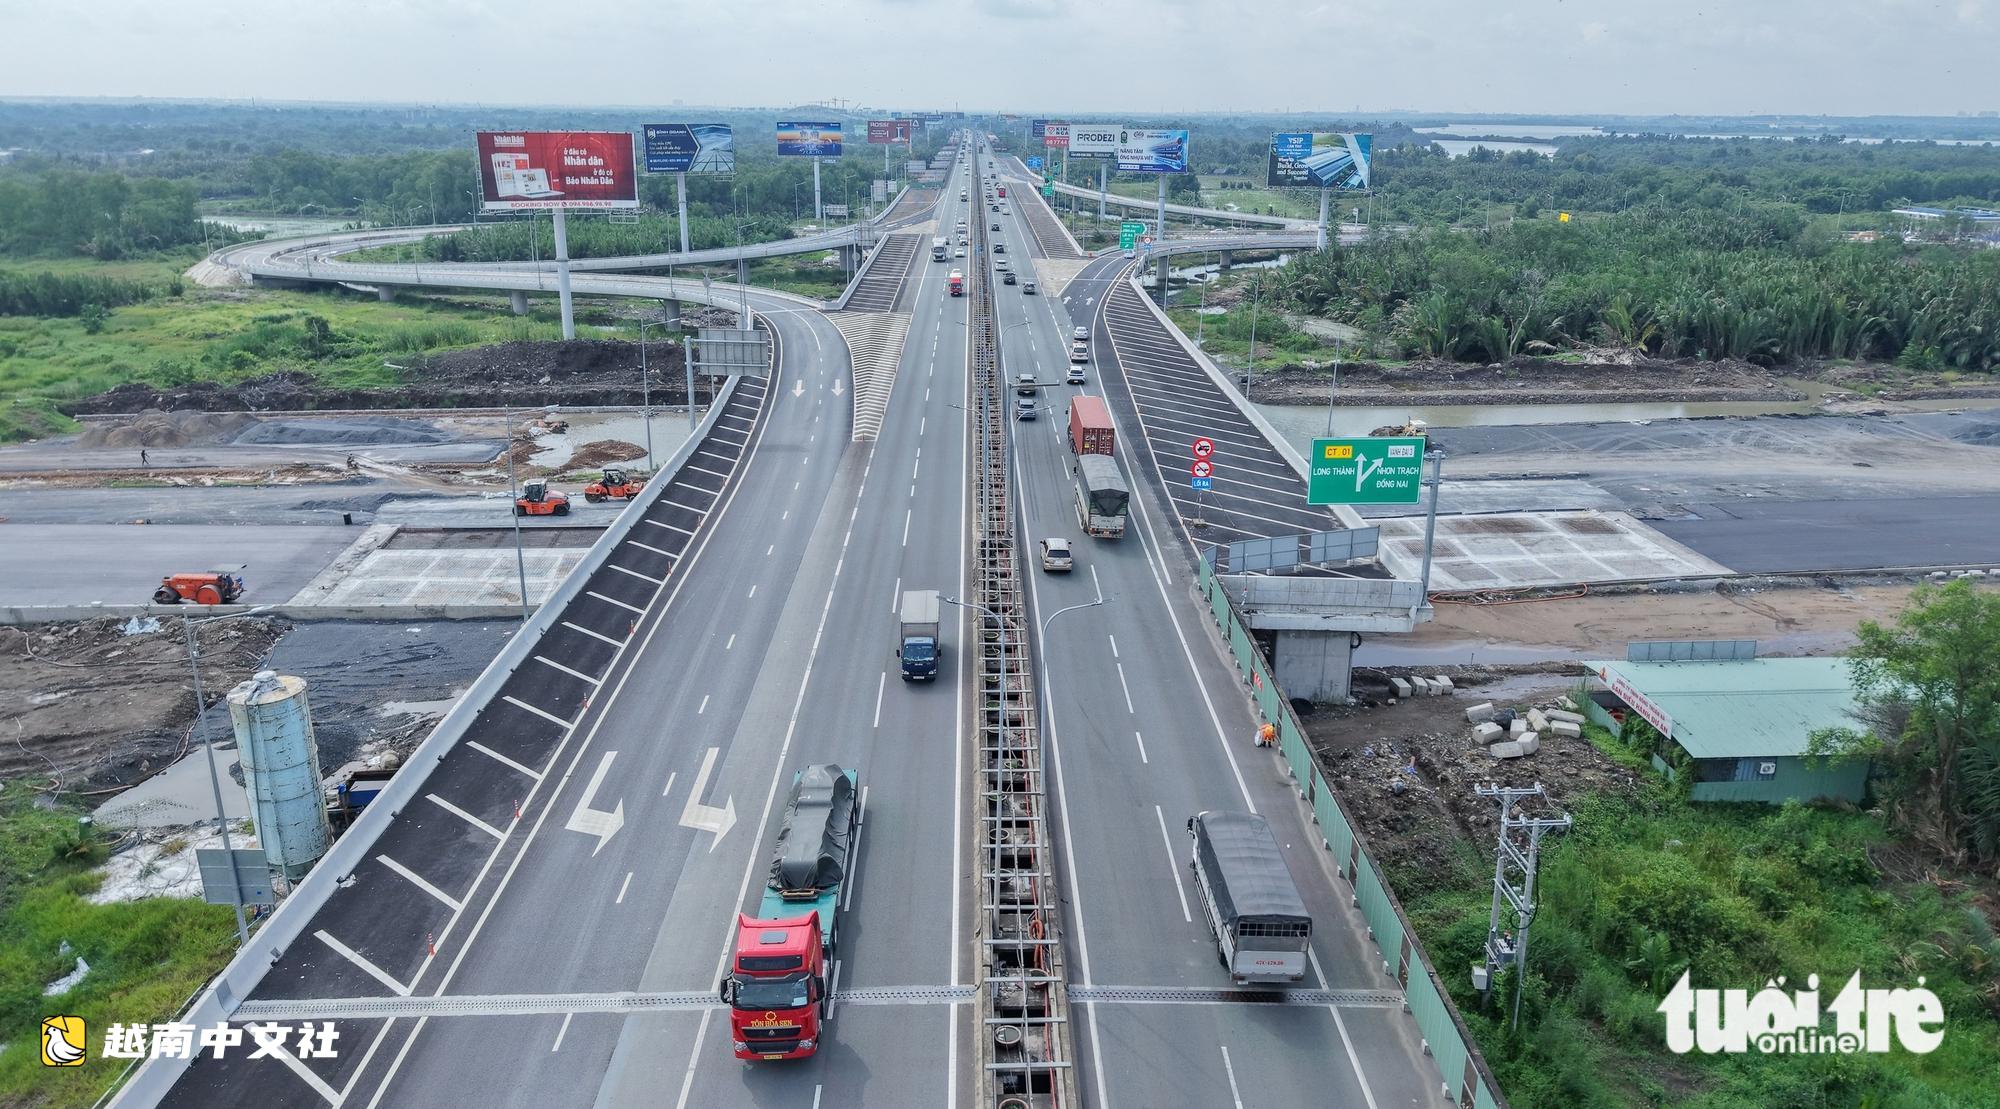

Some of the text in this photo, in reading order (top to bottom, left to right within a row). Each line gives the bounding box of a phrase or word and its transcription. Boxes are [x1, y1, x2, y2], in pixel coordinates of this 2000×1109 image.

[1077, 133, 1115, 142] PRODEZI
[564, 155, 604, 166] Nhân dân
[566, 176, 614, 185] Báo Nhân Dân
[1313, 465, 1356, 476] LONG THÀNH
[1376, 465, 1419, 477] NHƠN TRẠCH
[1376, 478, 1408, 488] ĐỒNG NAI
[1635, 703, 1651, 720] HÀNH
[751, 1019, 764, 1027] TÔN
[779, 1019, 793, 1027] SEN
